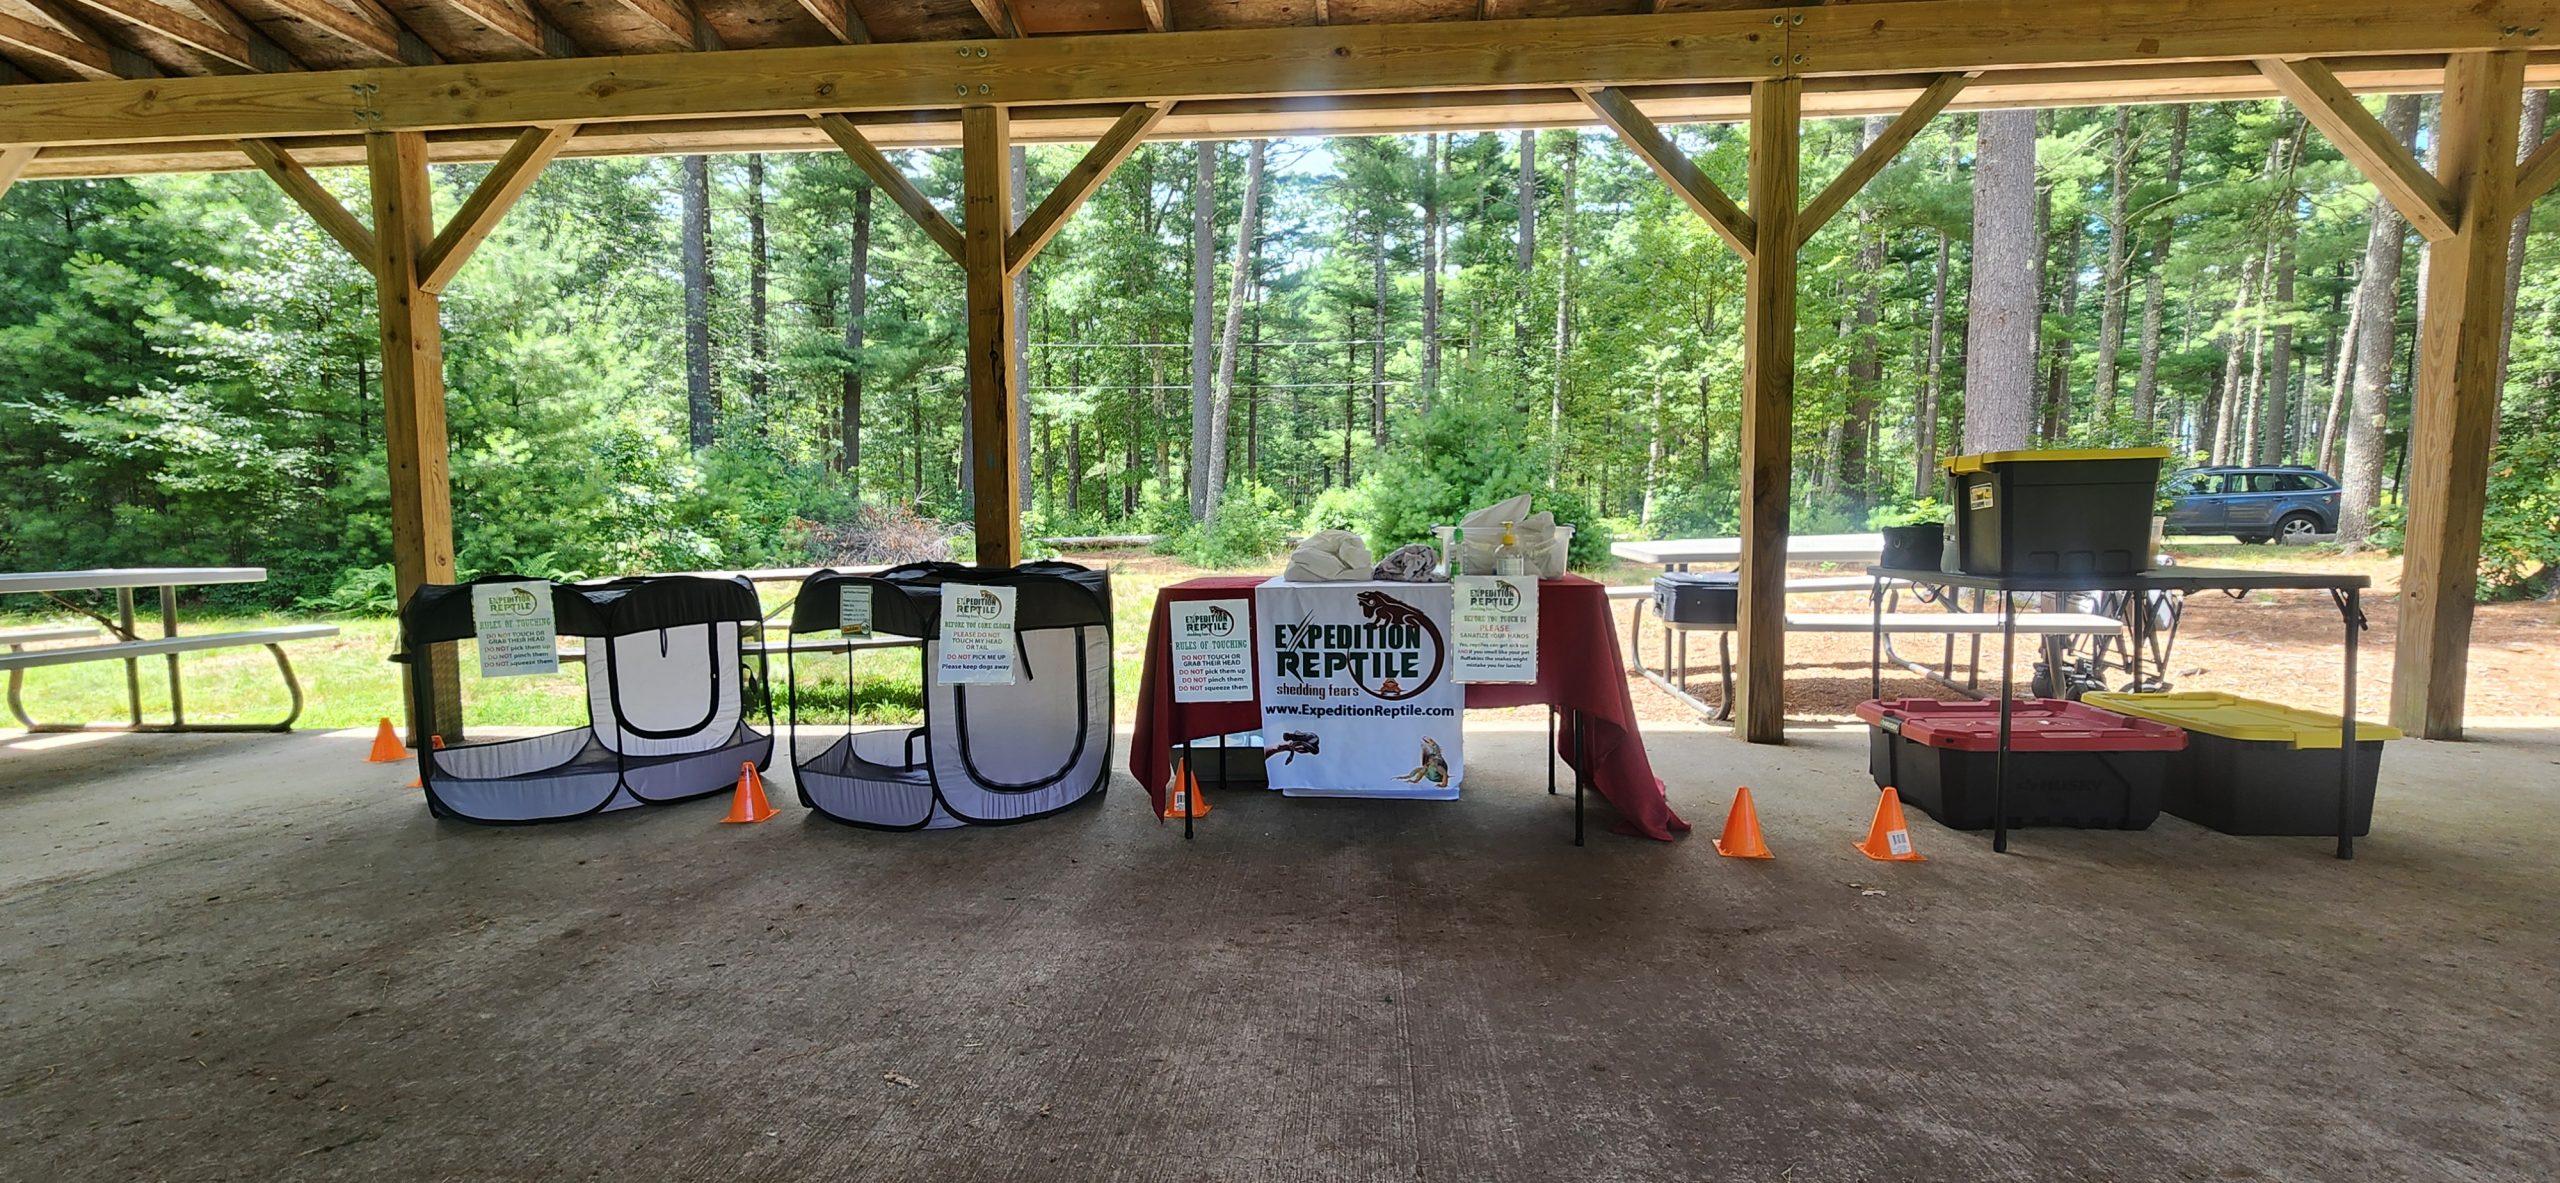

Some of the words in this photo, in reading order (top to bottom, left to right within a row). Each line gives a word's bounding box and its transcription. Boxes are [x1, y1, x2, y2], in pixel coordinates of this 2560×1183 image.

[956, 597, 996, 606] EXPEDITION
[1470, 598, 1514, 606] REPTILE
[490, 603, 532, 612] REPTILE
[956, 606, 995, 614] REPTILE
[480, 621, 501, 630] RULES
[517, 617, 551, 627] TOUCHING
[1186, 614, 1228, 623] EXPEDITION
[1187, 623, 1228, 632] REPTILE
[1274, 624, 1421, 649] EXPEDITION
[1175, 641, 1197, 651] RULES
[1200, 641, 1209, 650] OF
[1212, 640, 1247, 649] TOUCHING
[1276, 651, 1420, 680] REPTILE
[1276, 683, 1326, 700] shedding
[1329, 684, 1359, 697] fears
[1265, 704, 1455, 719] www.ExpeditionReptile.com
